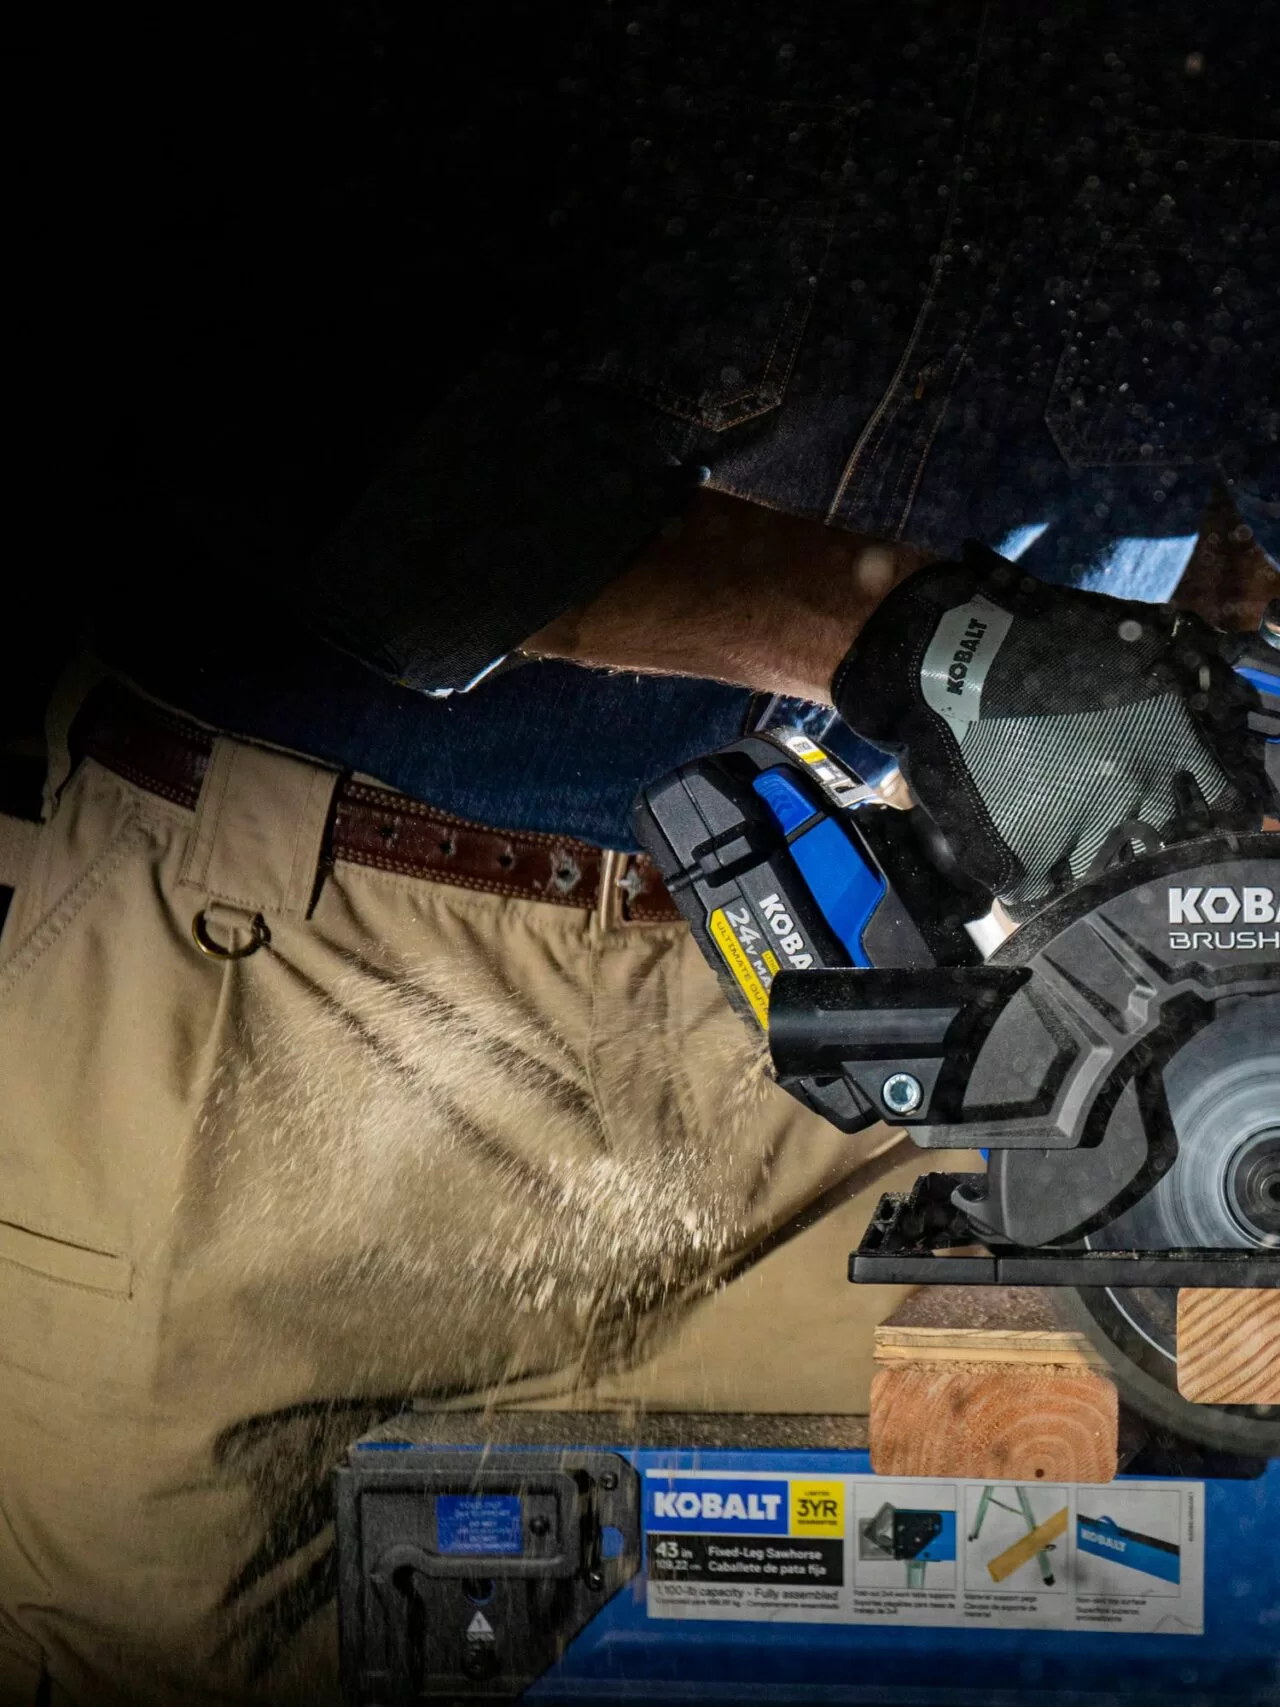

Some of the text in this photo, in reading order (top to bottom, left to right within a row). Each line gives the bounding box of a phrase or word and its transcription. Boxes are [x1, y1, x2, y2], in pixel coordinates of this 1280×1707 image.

[946, 617, 988, 696] KOBALT
[758, 893, 814, 969] KOBA
[716, 921, 769, 1016] ULTIMATE OUT
[752, 960, 772, 989] MA
[654, 1491, 782, 1521] KOBALT
[796, 1499, 838, 1518] 3YR
[655, 1541, 679, 1559] 43
[707, 1545, 823, 1561] Fixed-Leg Sawhorse
[708, 1560, 828, 1577] Caballete de pata fija
[699, 1587, 745, 1599] capacity
[754, 1587, 779, 1600] Fully
[782, 1590, 840, 1601] assembled
